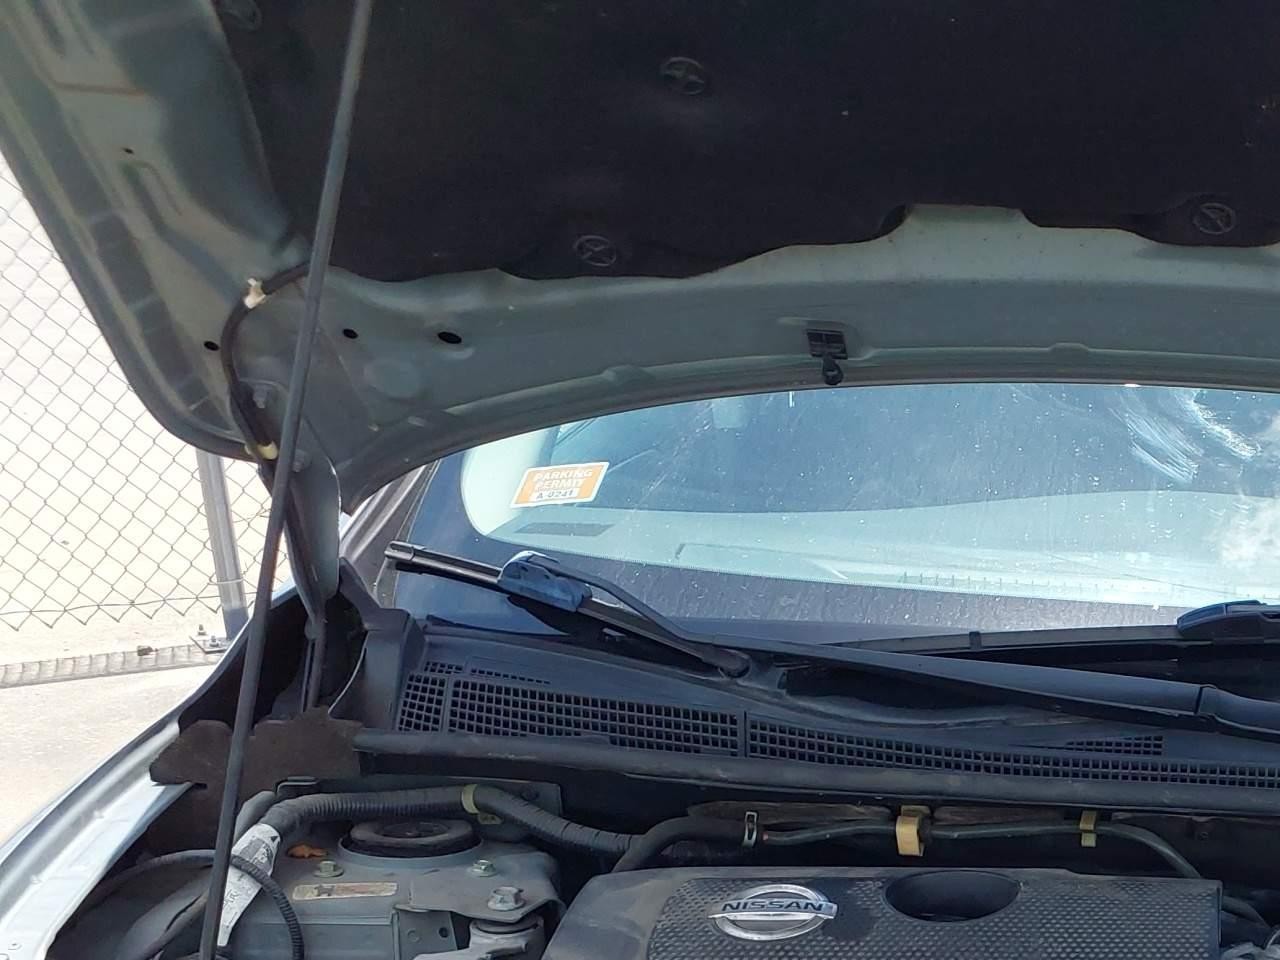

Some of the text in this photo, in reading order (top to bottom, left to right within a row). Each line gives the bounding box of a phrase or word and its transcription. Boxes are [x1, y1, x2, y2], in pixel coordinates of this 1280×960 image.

[533, 468, 593, 481] PARKING
[534, 477, 584, 490] PERMIT
[721, 901, 824, 912] NISSAN
